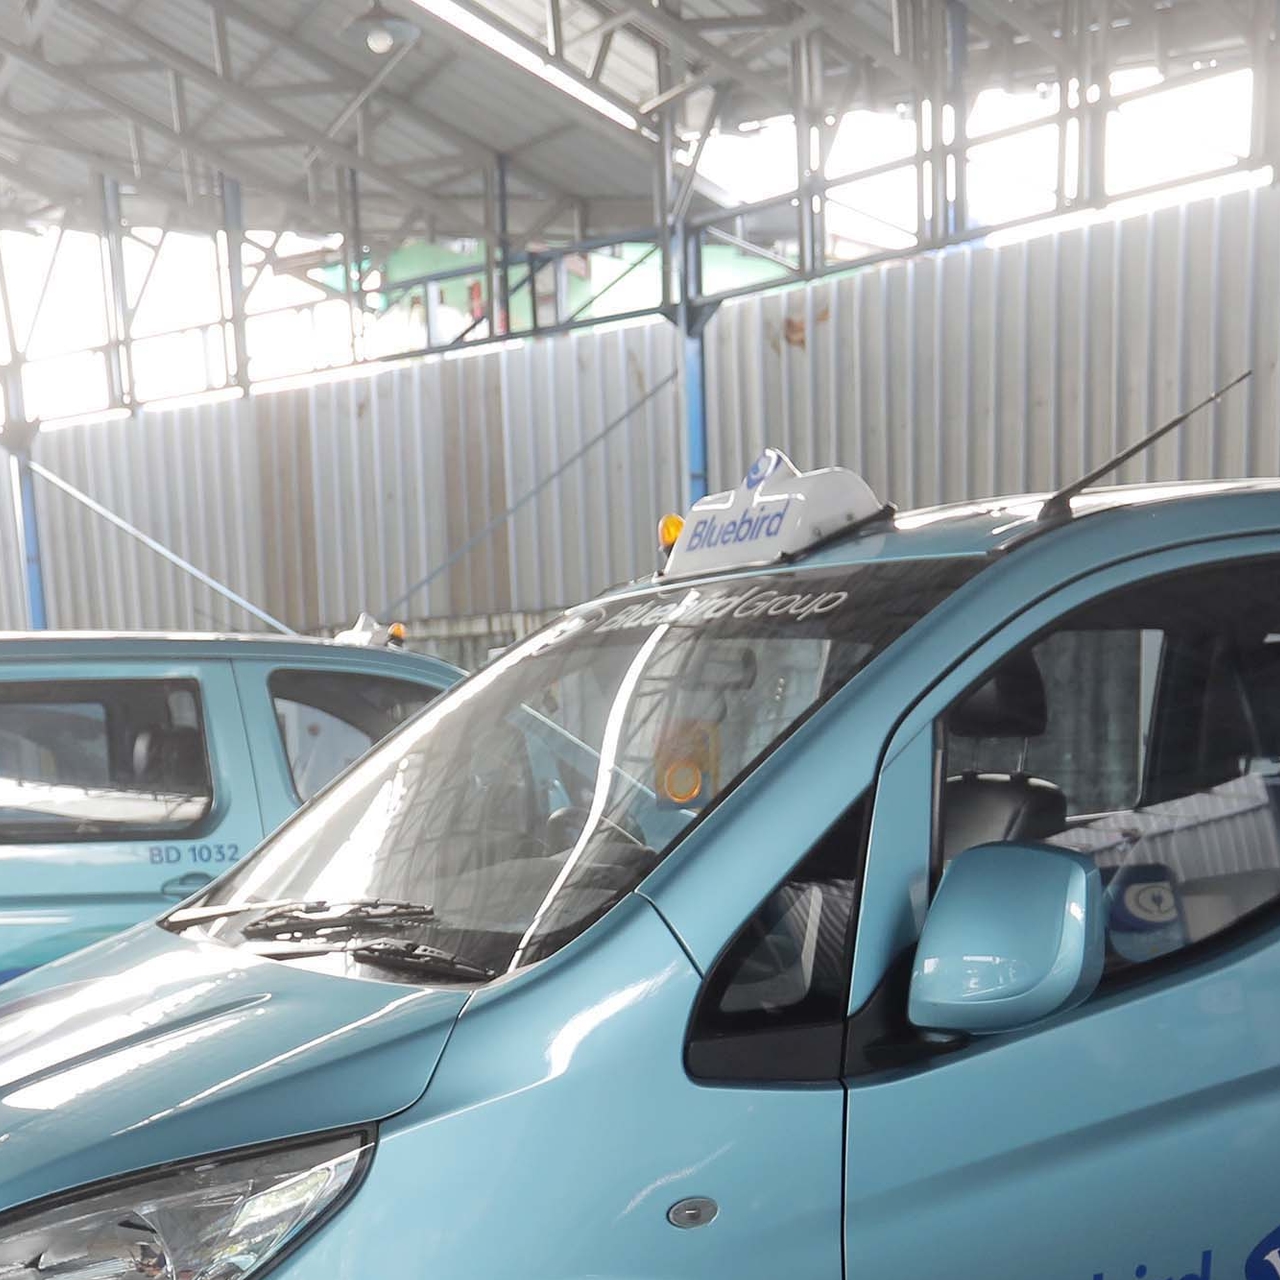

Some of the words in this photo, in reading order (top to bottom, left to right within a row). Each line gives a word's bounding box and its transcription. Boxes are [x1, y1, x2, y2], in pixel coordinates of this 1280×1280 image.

[685, 499, 790, 551] Bluebird
[149, 846, 181, 865] BD
[188, 844, 239, 863] 1032
